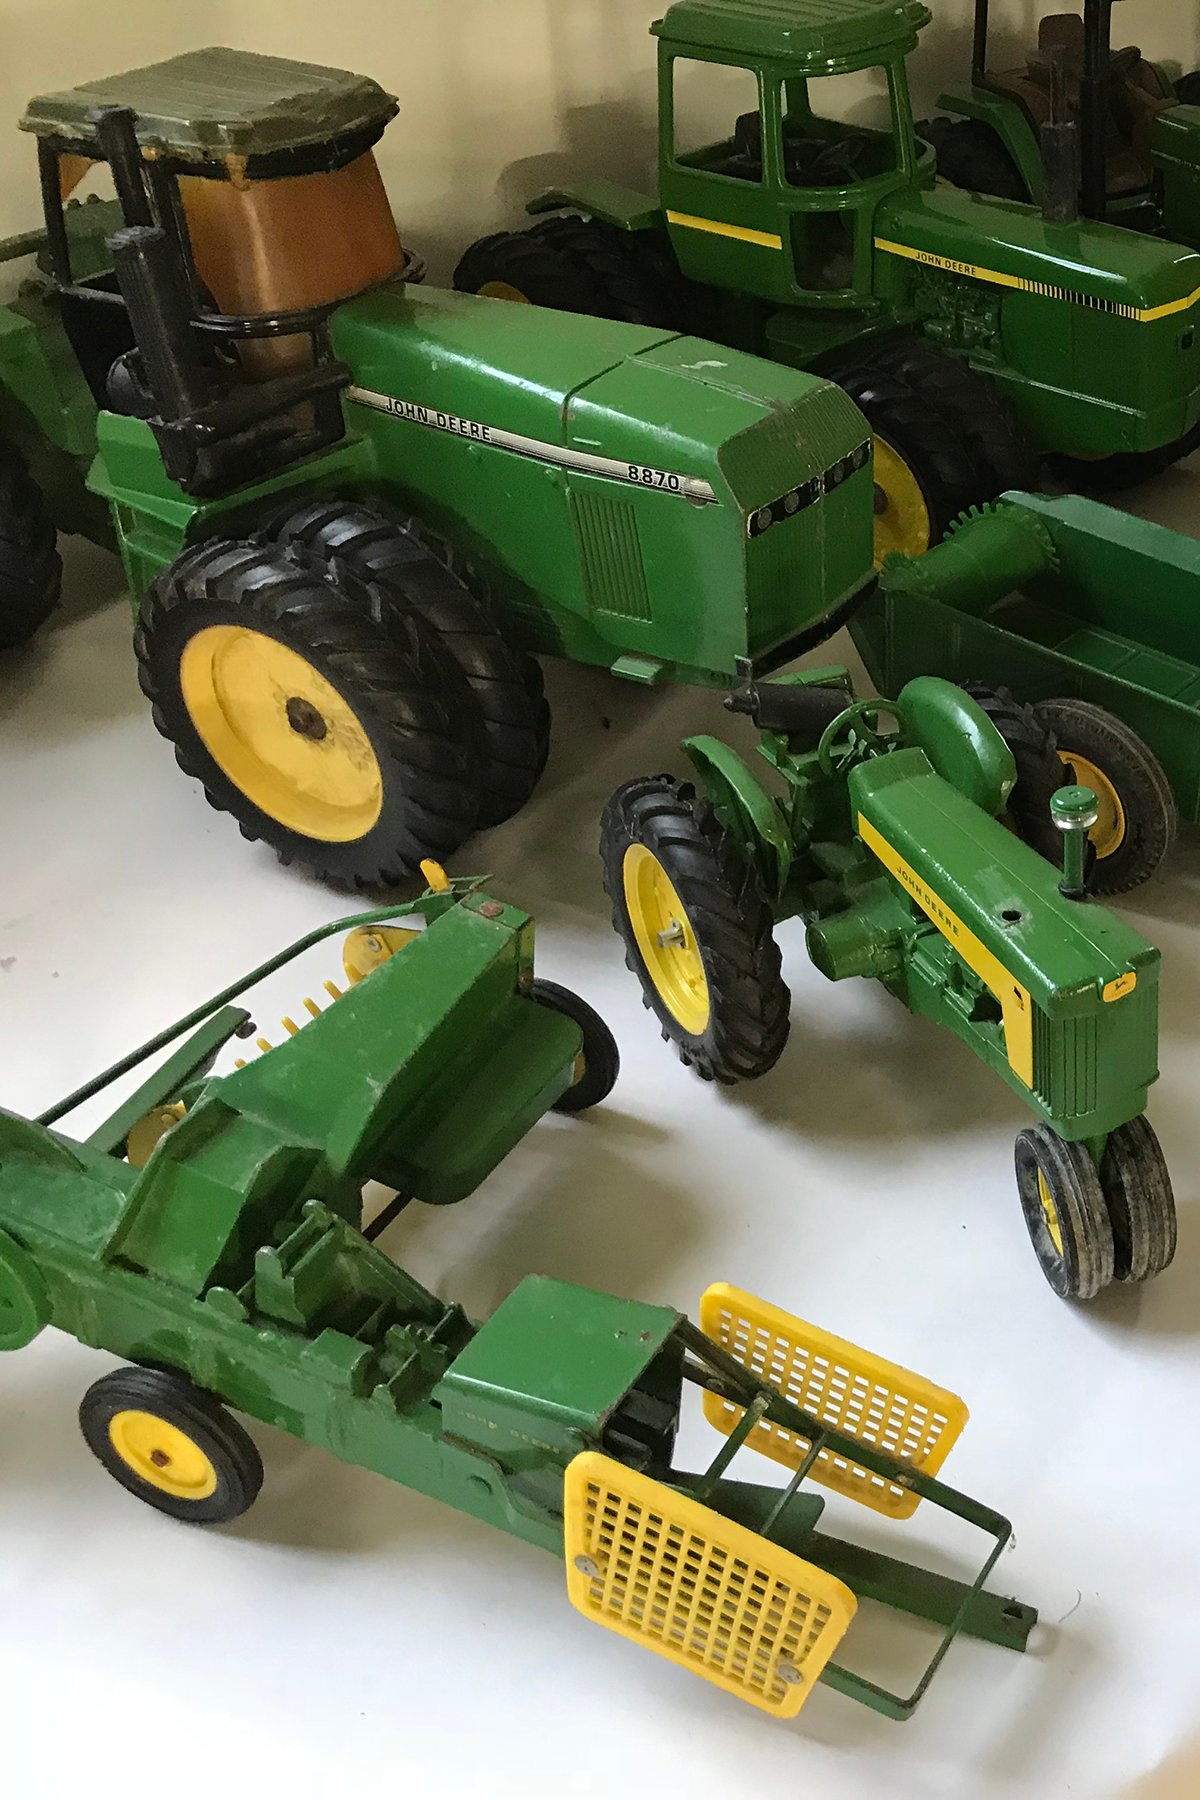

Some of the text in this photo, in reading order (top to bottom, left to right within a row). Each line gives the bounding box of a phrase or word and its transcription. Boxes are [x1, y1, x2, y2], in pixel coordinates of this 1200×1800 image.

[915, 251, 977, 276] JOHN DEERE
[386, 398, 491, 441] JOHN DEERE
[628, 465, 680, 490] 8870
[896, 866, 960, 937] JOHN DEERE
